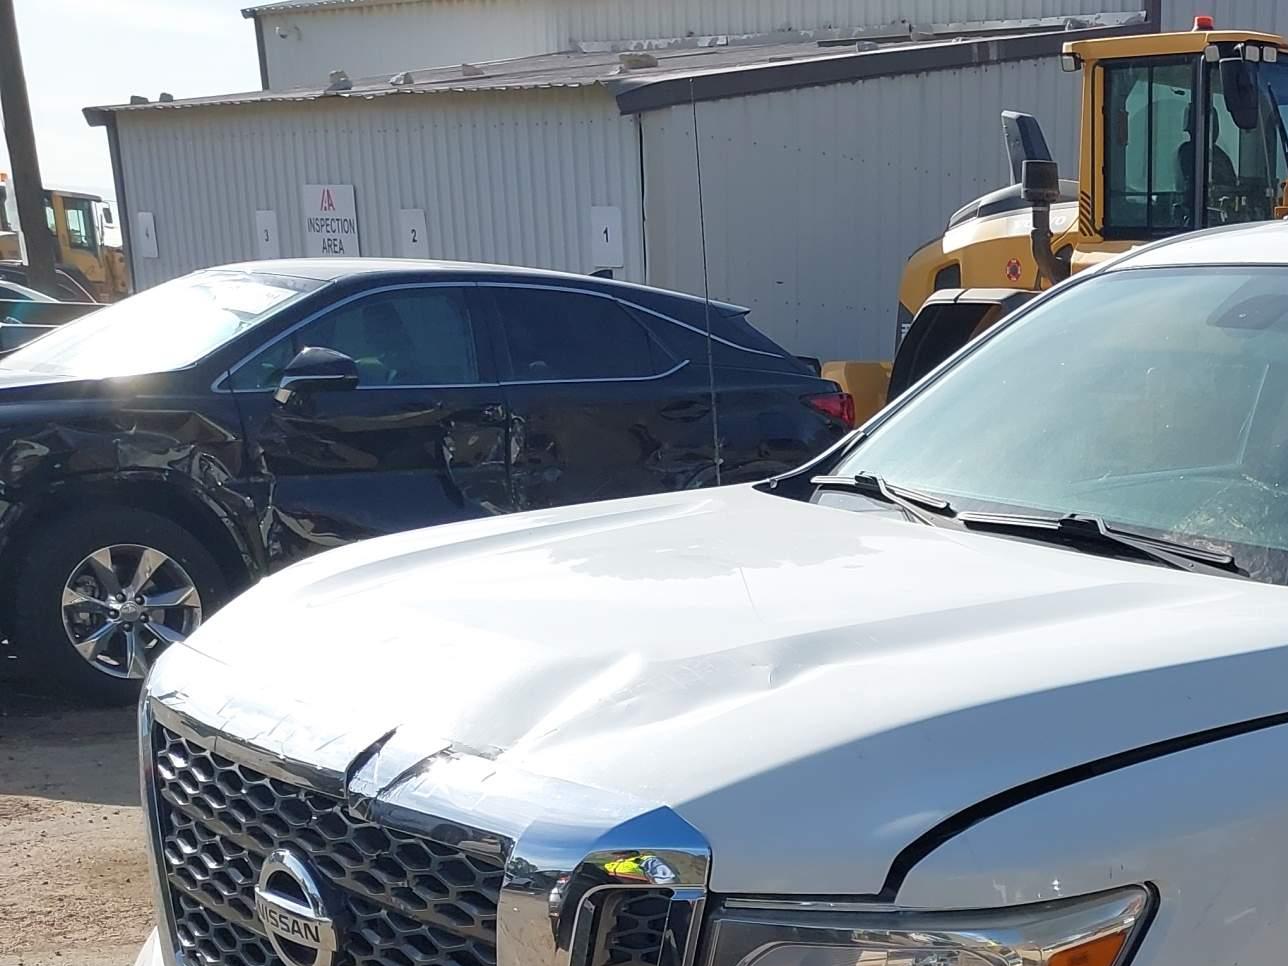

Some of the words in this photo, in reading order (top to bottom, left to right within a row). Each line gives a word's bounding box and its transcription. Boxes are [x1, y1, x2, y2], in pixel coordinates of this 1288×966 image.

[307, 217, 356, 235] INSPECTION
[263, 228, 270, 242] 3
[410, 228, 418, 243] 2
[602, 226, 609, 244] 1
[322, 238, 345, 255] AREA
[258, 903, 321, 943] NISSAN
